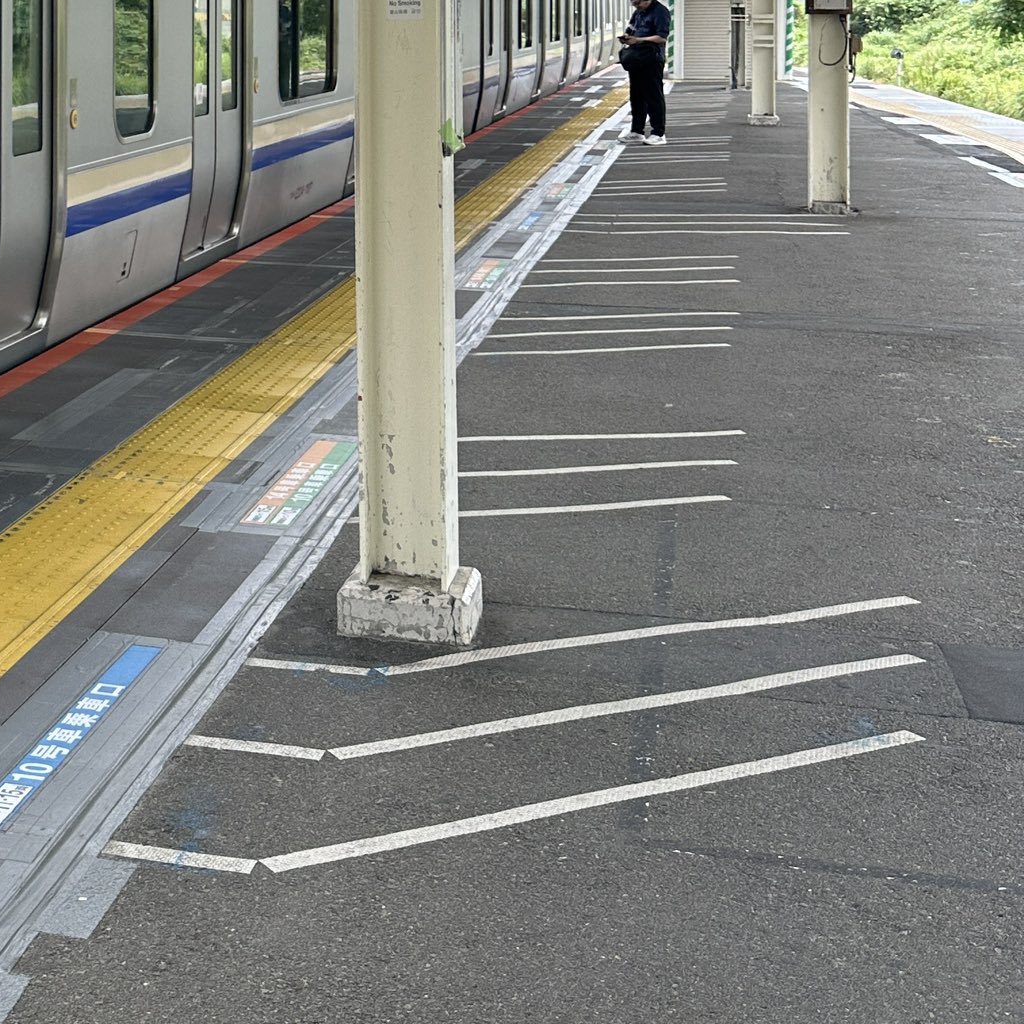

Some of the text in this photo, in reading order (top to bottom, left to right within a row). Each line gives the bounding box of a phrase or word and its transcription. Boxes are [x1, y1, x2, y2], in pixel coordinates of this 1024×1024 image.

[397, 0, 421, 7] Smoking
[11, 682, 126, 782] 10号車乗車口
